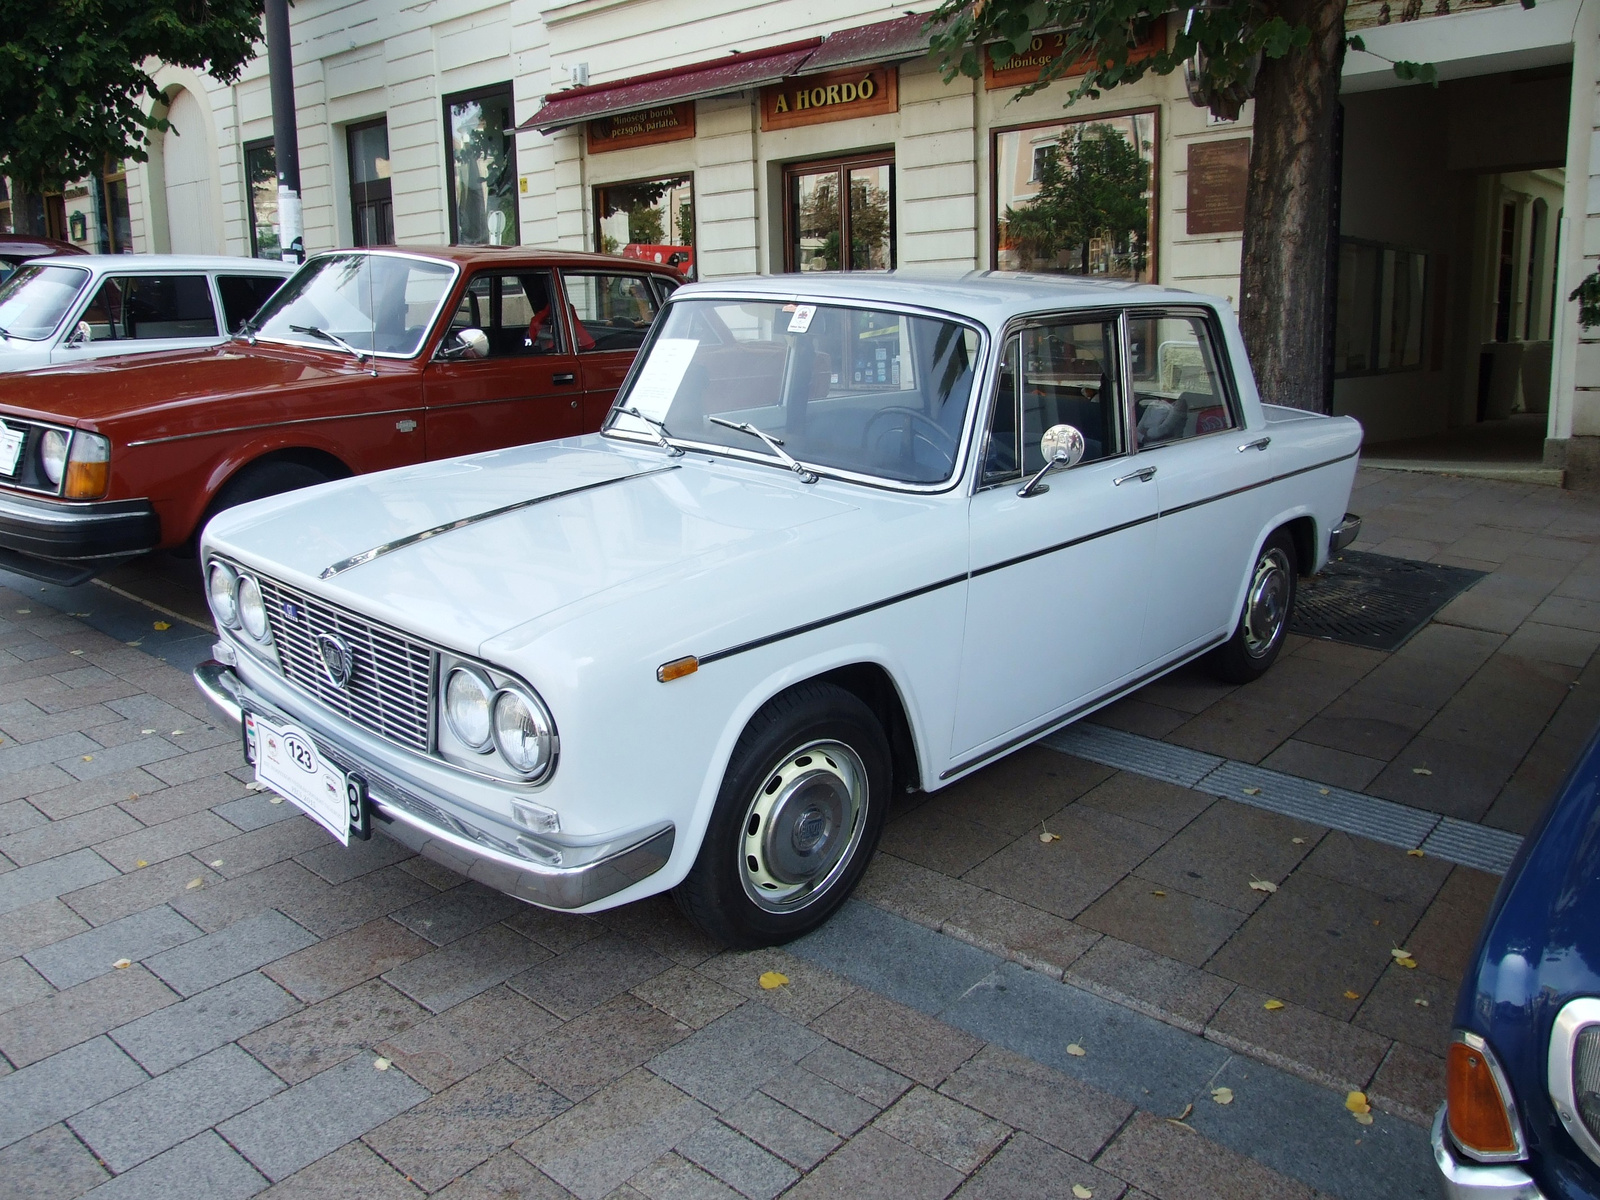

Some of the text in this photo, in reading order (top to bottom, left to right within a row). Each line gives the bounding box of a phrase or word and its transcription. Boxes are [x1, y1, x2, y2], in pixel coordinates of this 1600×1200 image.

[774, 73, 874, 113] A HORDÓ
[650, 106, 674, 119] borok
[289, 740, 312, 770] 123
[347, 783, 360, 822] 8
